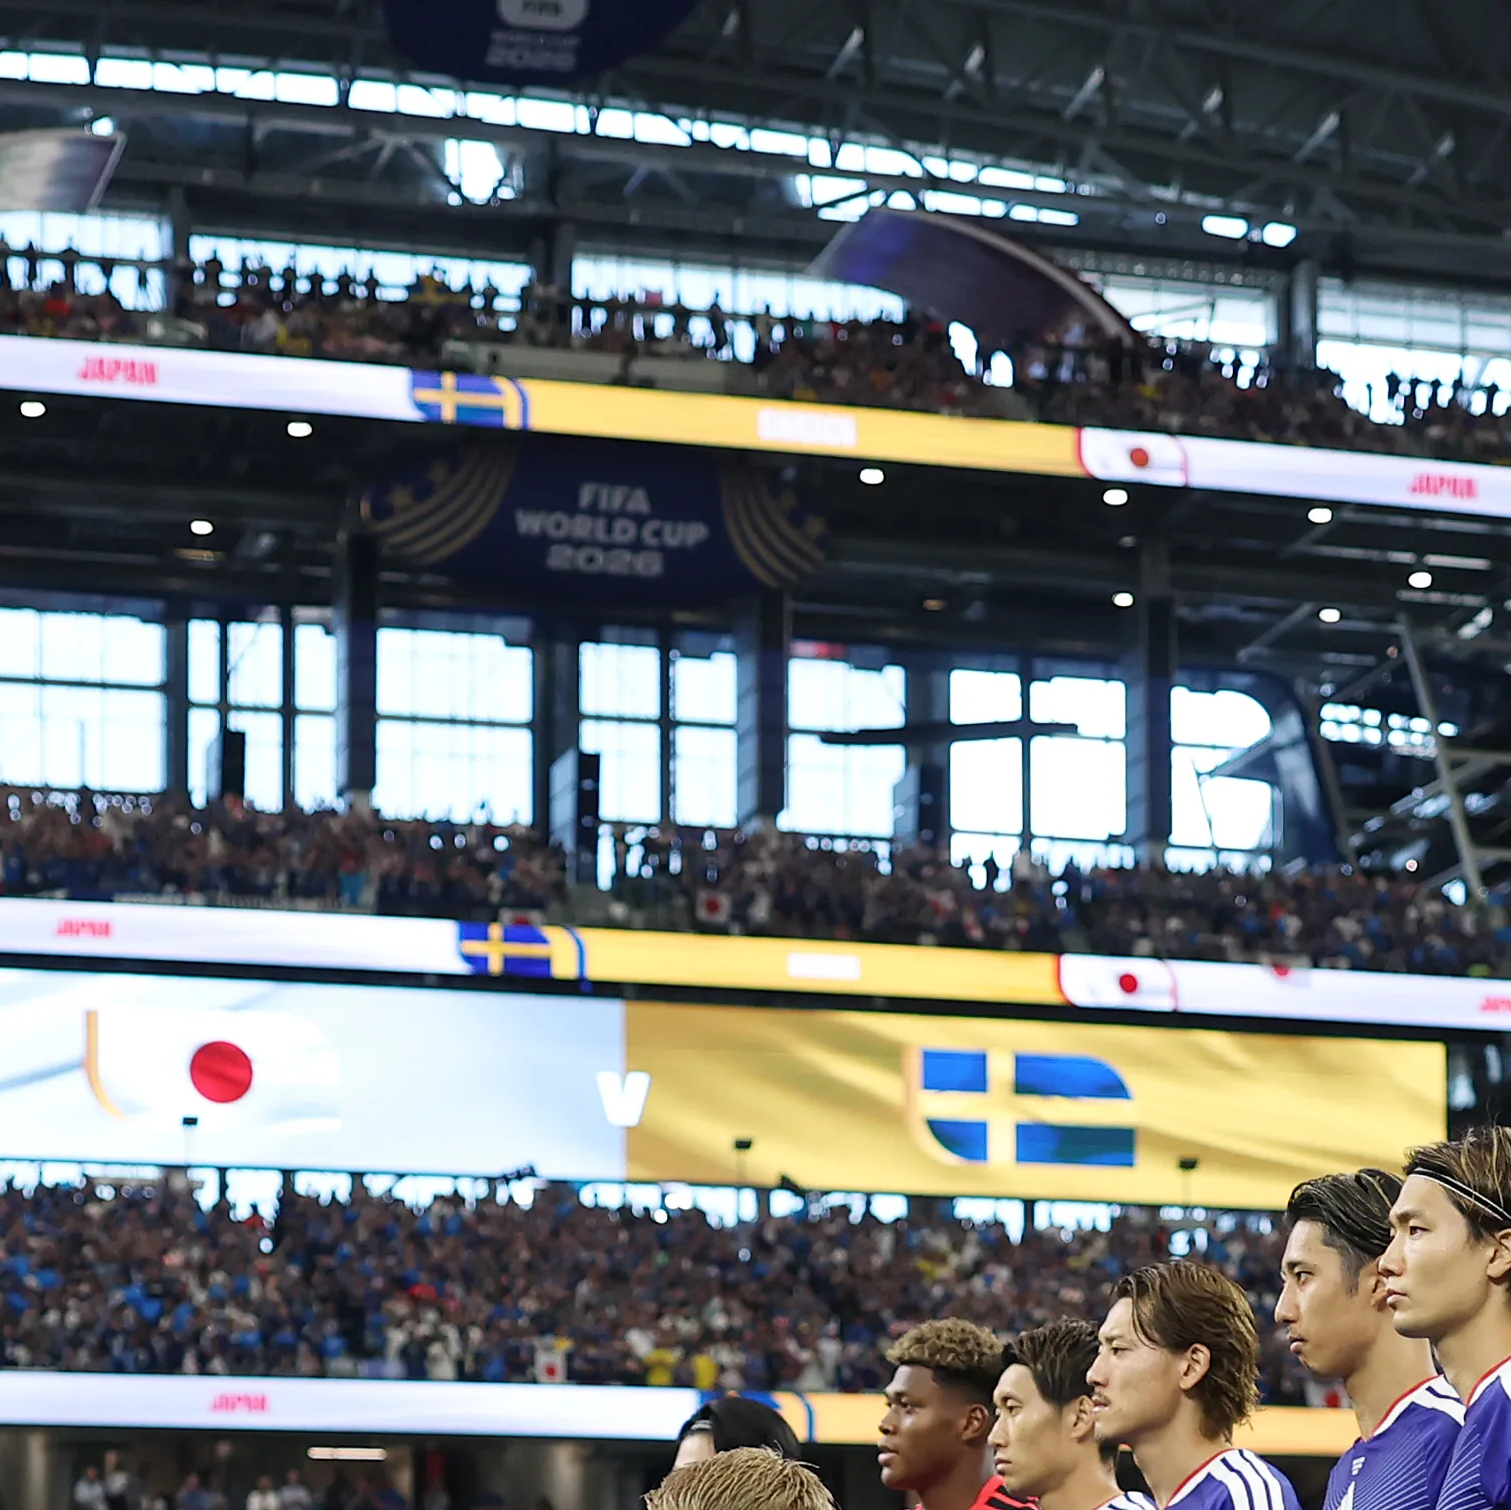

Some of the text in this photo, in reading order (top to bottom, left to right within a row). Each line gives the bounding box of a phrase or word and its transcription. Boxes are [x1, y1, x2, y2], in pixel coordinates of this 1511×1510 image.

[578, 483, 651, 514] FIFA
[515, 509, 709, 548] WORLD CUP
[546, 544, 664, 577] 2026
[595, 1070, 651, 1128] V
